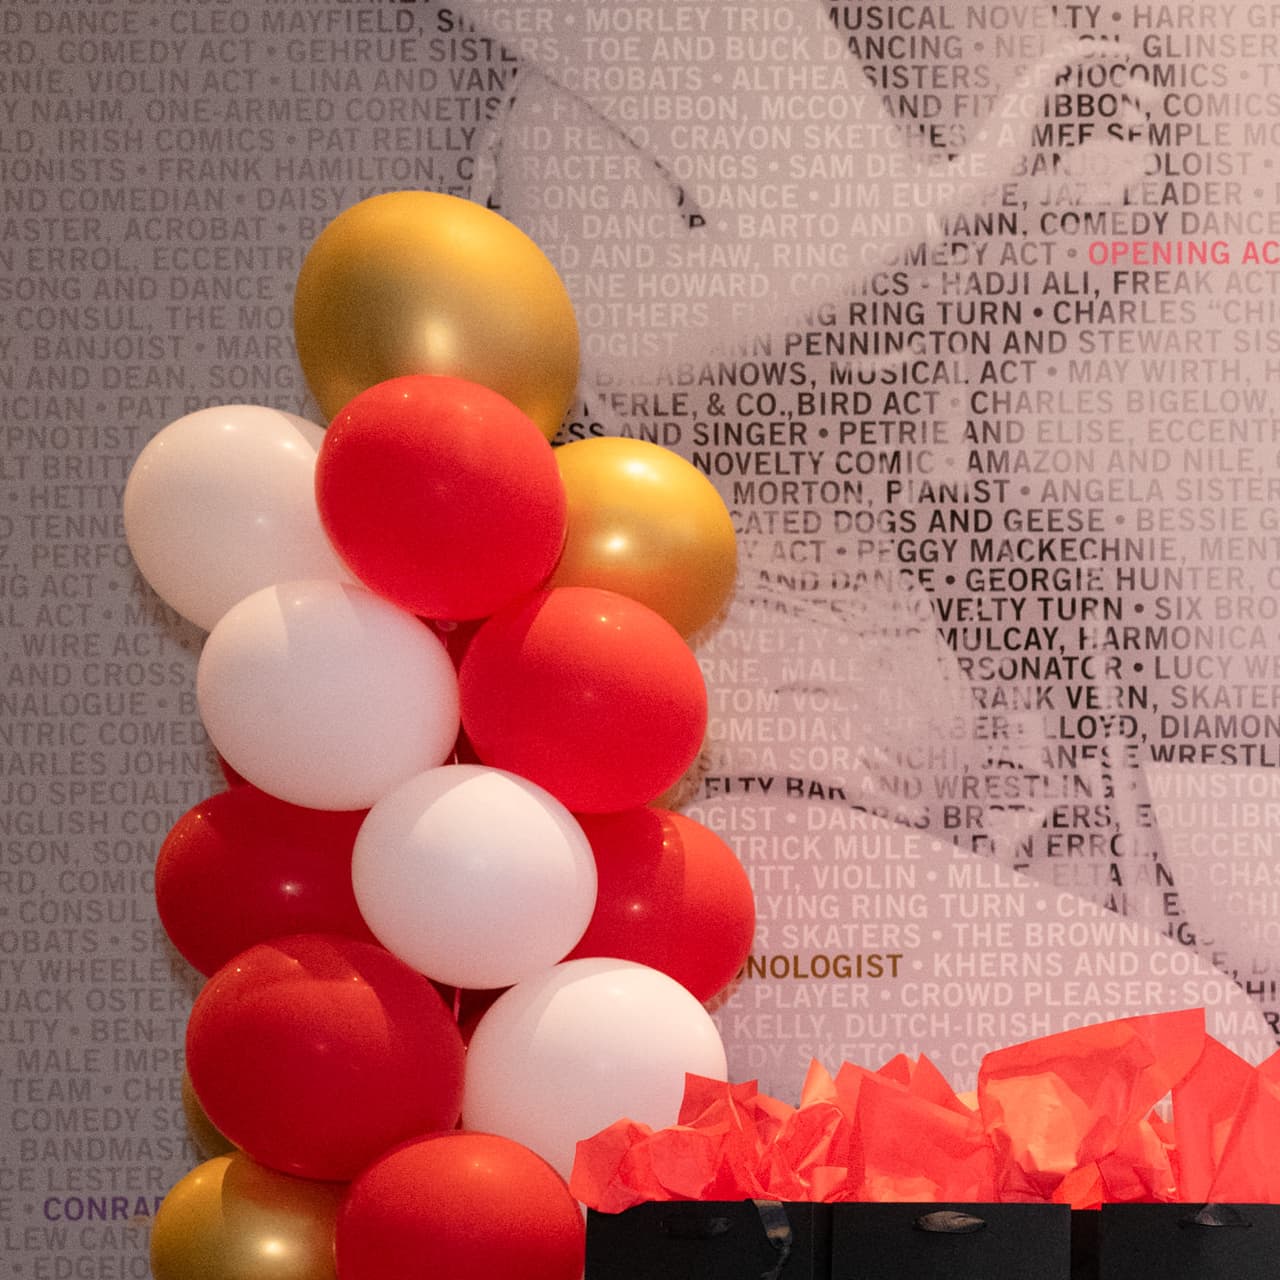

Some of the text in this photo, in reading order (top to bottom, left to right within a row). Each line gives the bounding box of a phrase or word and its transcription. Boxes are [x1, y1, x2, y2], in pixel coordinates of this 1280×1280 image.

[307, 127, 368, 152] PAT
[1039, 211, 1169, 236] COMEDY
[999, 241, 1056, 267] ACT
[1088, 241, 1230, 266] OPENING
[942, 271, 1030, 296] HADJI
[1041, 270, 1100, 298] ALI,
[1112, 269, 1212, 295] FREAK
[849, 299, 1197, 326] RING TURN CHARLES
[1002, 329, 1067, 355] AND
[1077, 328, 1215, 354] STEWART
[969, 389, 1114, 415] CHARLES
[692, 421, 807, 447] SINGER
[964, 419, 1027, 445] AND
[692, 451, 824, 476] NOVELTY
[967, 449, 1094, 474] AMAZON
[732, 480, 873, 505] MORTON,
[928, 508, 993, 533] AND
[1002, 508, 1104, 533] GEESE
[1135, 507, 1247, 533] BESSIE
[1115, 566, 1258, 592] HUNTER,
[22, 632, 169, 657] WIRE ACT
[8, 663, 72, 687] AND
[730, 834, 922, 861] TRICK MULE
[851, 893, 1025, 919] RING TURN
[1074, 951, 1139, 977] AND
